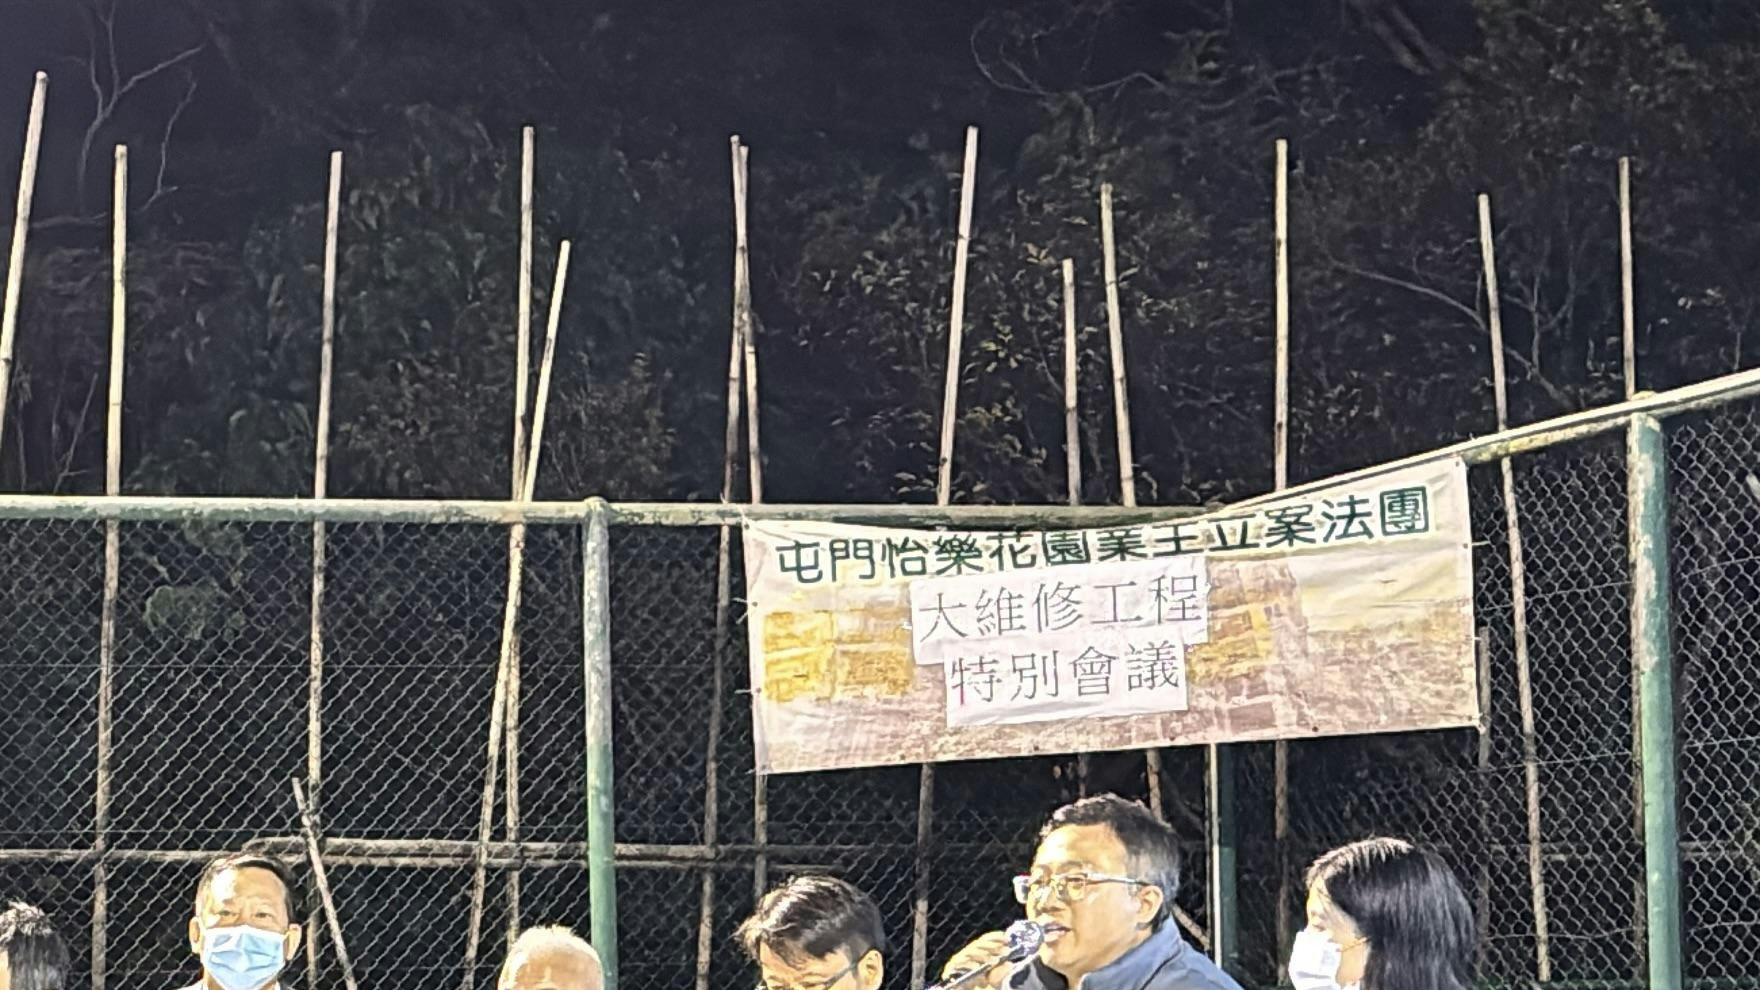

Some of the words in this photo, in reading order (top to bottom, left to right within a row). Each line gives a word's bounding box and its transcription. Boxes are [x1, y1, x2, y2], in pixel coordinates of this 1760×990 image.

[775, 486, 1430, 585] 屯門怡樂花園業主立案法團
[919, 573, 1203, 643] 大維修工程
[951, 639, 1179, 705] 特別會議
